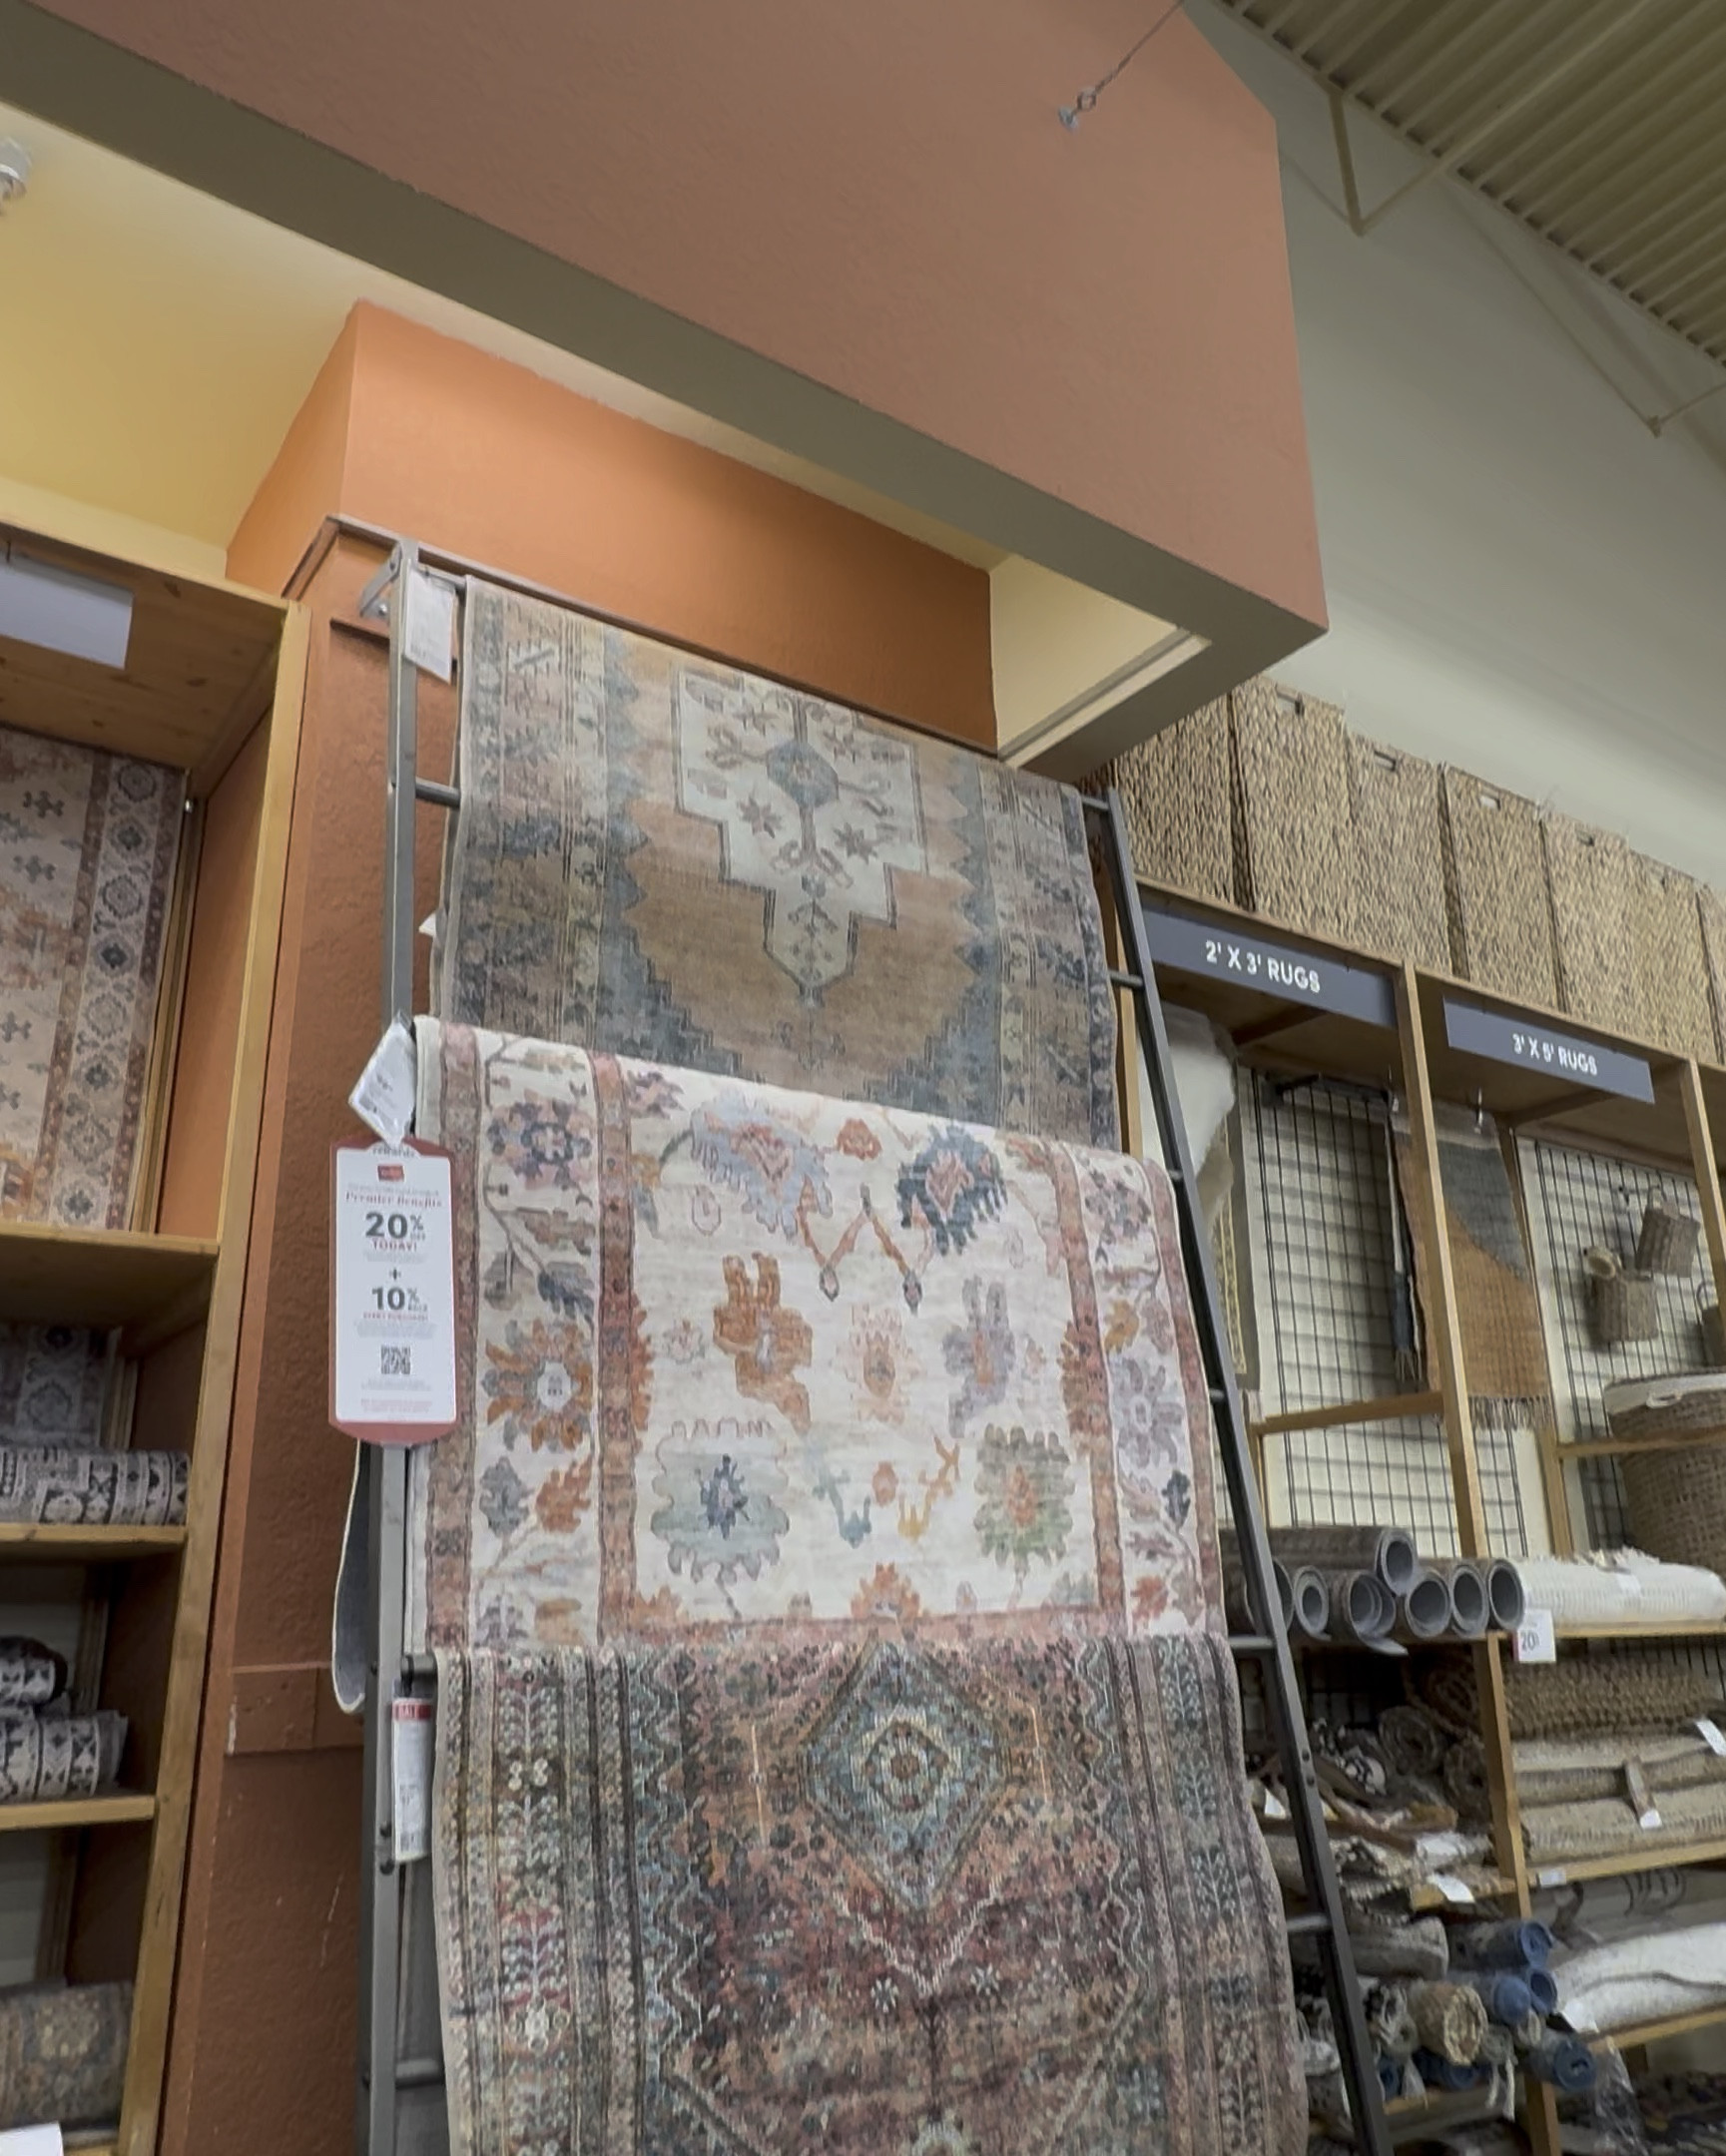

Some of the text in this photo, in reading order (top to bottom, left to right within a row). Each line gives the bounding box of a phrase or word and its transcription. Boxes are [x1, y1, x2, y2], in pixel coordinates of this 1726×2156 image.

[1205, 939, 1321, 993] 2' X 3' RUGS
[1512, 1033, 1525, 1055] 3'
[1527, 1036, 1540, 1059] X
[1558, 1045, 1598, 1076] RUGS
[365, 1212, 424, 1240] 20%
[371, 1286, 420, 1311] 10%
